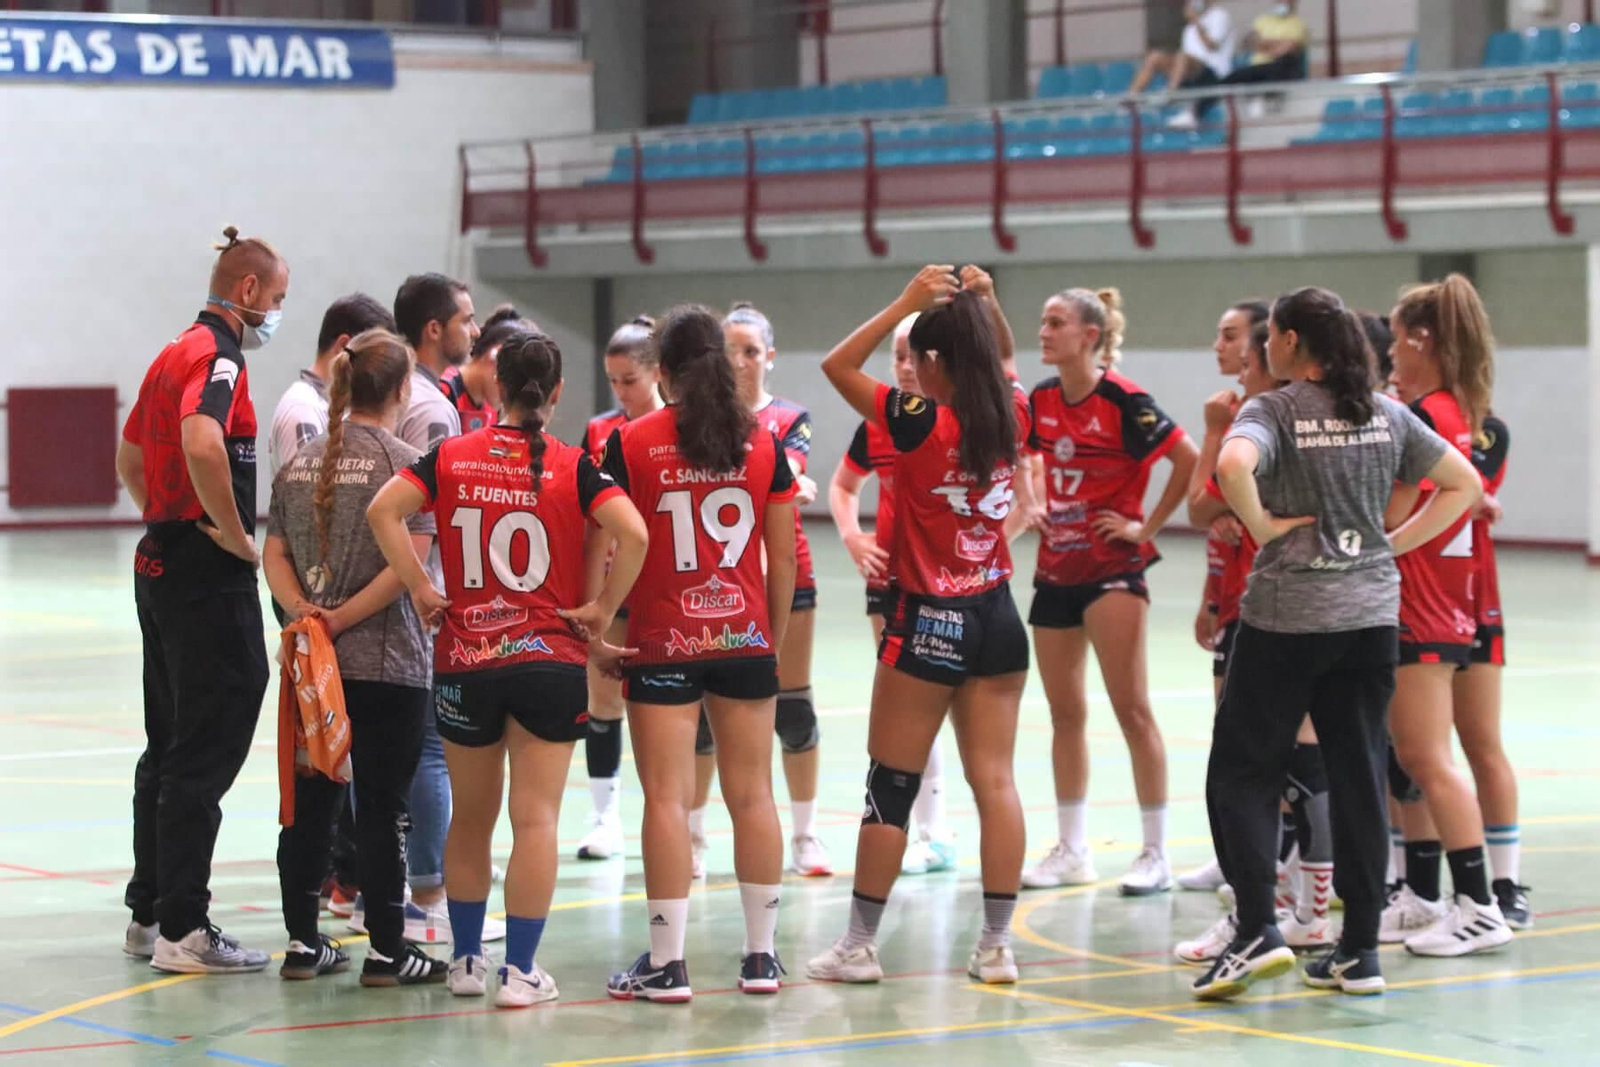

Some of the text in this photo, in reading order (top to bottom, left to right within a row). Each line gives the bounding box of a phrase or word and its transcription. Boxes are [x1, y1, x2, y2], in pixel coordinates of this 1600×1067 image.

[136, 33, 209, 75] DE
[228, 35, 353, 79] MAR
[1295, 418, 1322, 433] BM.
[1332, 435, 1347, 446] DE
[311, 458, 375, 471] RUETAS
[660, 469, 674, 485] C.
[333, 471, 368, 485] LMERÍA
[1051, 466, 1085, 496] 17
[458, 484, 538, 507] S. FUENTES
[930, 479, 1014, 520] 16
[656, 486, 756, 573] 19
[450, 506, 551, 593] 10
[690, 592, 741, 610] Discar
[450, 630, 554, 666] Andalucía
[665, 621, 769, 656] Andalucía
